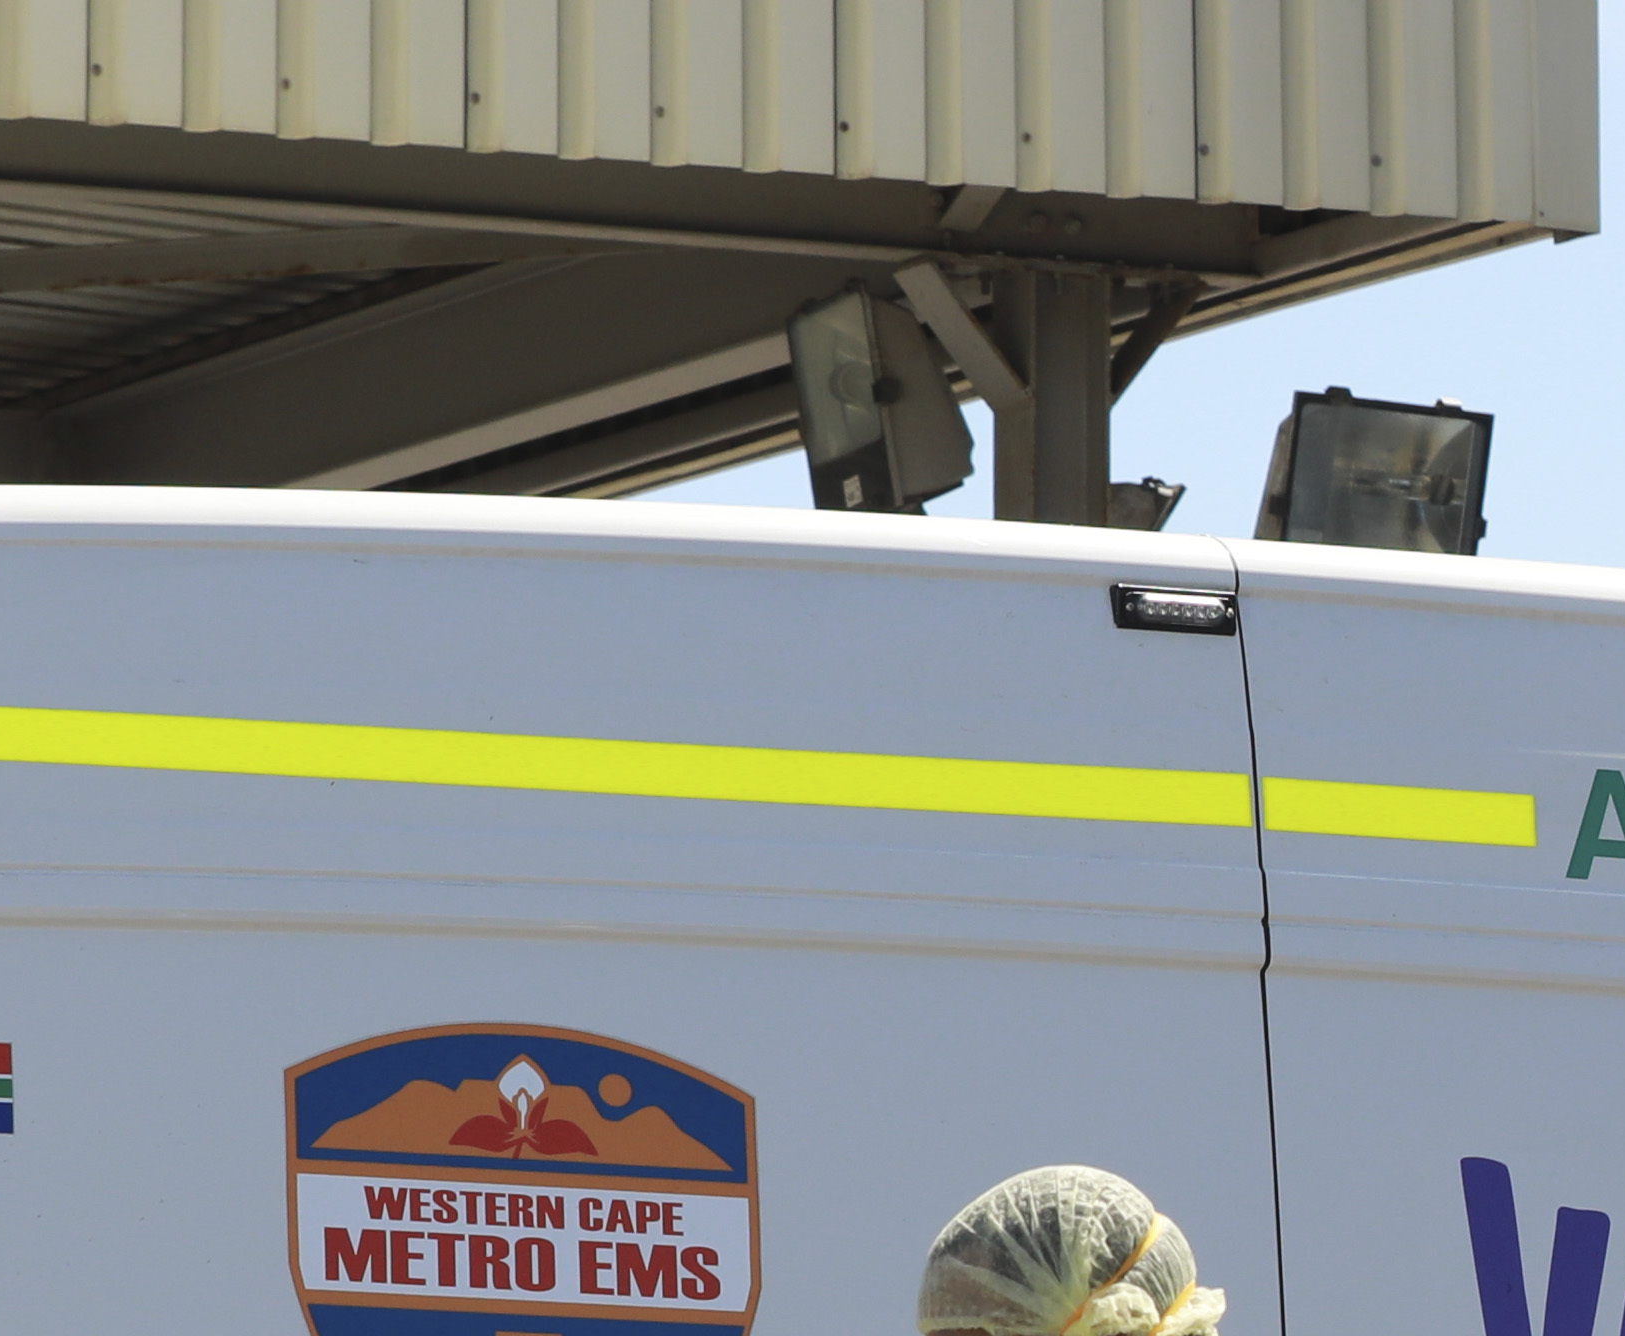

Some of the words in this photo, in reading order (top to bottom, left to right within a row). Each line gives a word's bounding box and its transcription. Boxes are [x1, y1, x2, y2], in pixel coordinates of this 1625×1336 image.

[366, 1185, 565, 1232] WESTERN
[578, 1196, 685, 1237] CAPE
[323, 1226, 557, 1293] METRO
[577, 1239, 721, 1301] EMS
